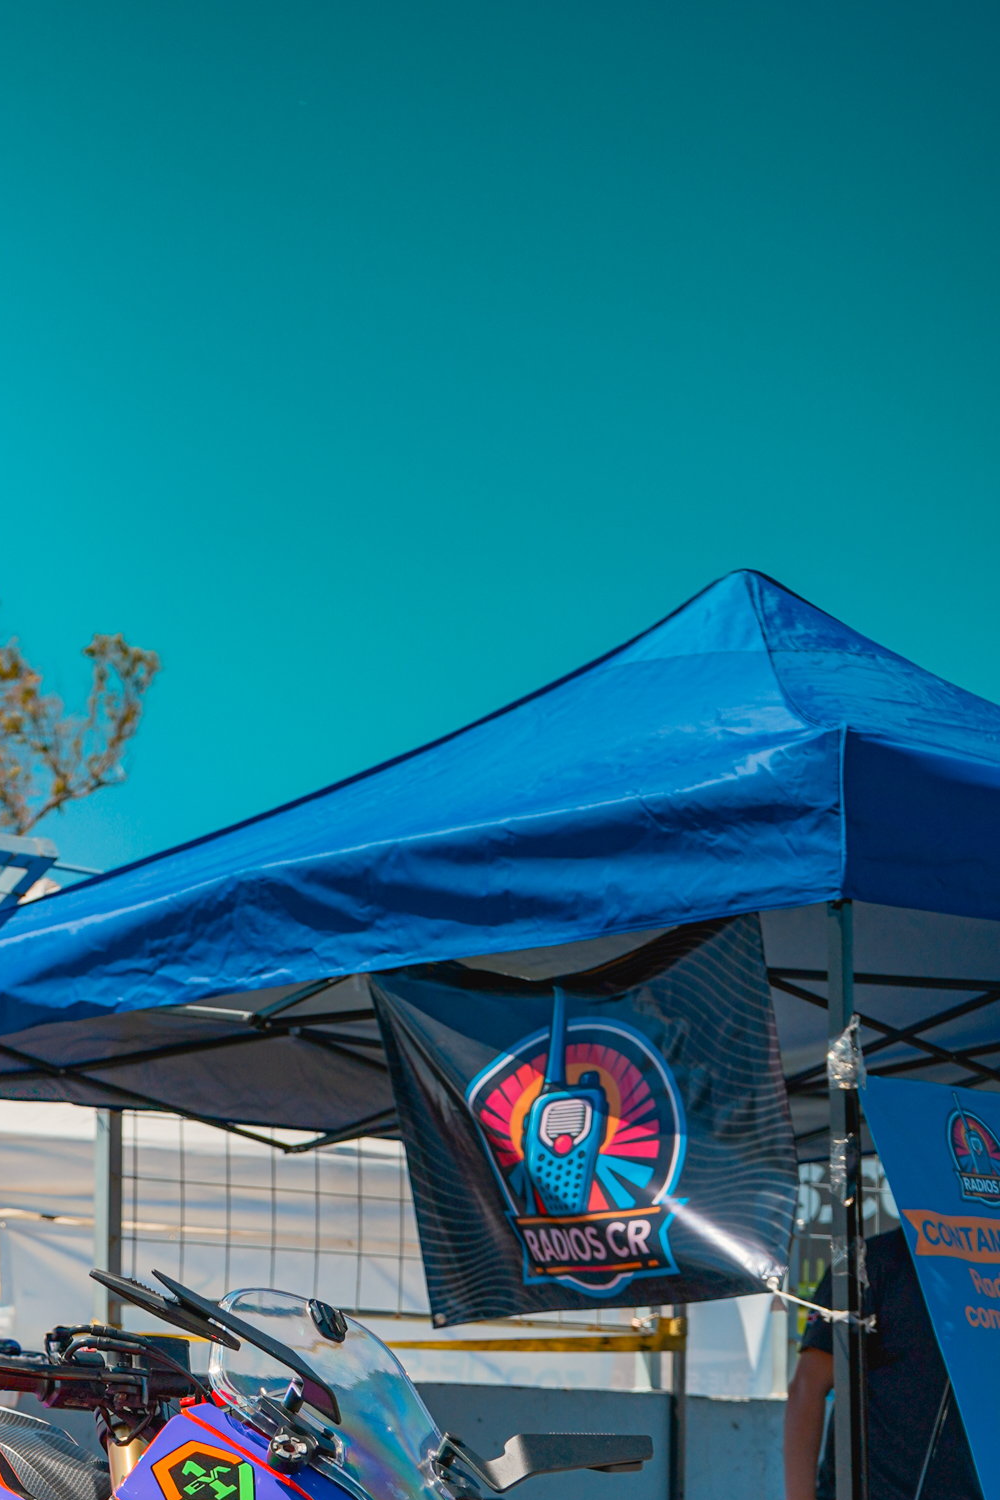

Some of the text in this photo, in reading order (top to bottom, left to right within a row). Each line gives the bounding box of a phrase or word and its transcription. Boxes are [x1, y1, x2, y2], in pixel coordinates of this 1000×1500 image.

[963, 1176, 999, 1194] RADIOS
[523, 1219, 652, 1263] RADIOS CR
